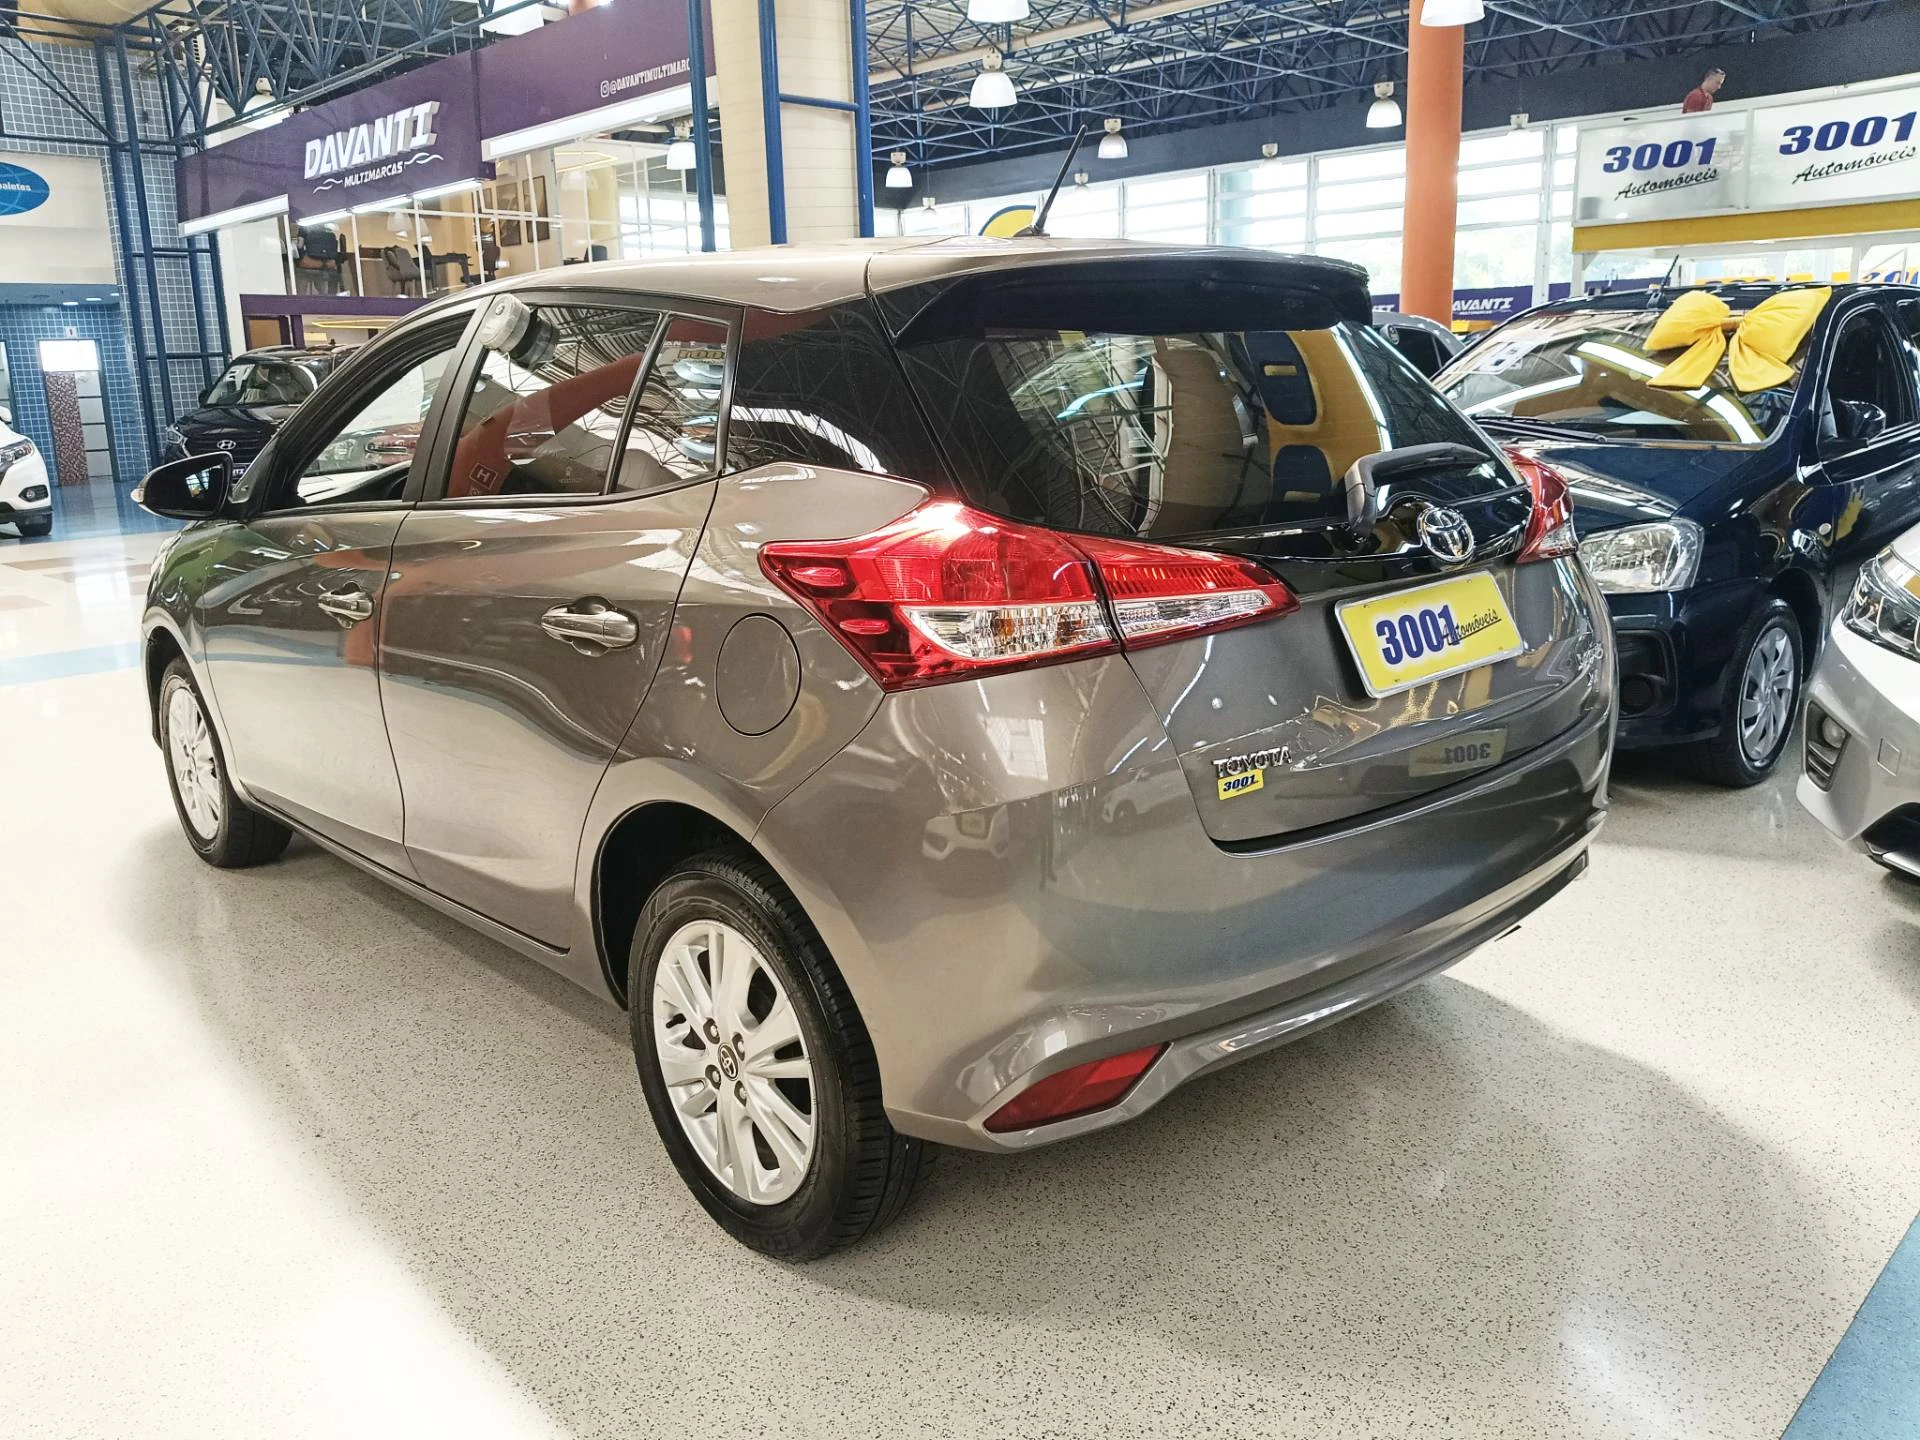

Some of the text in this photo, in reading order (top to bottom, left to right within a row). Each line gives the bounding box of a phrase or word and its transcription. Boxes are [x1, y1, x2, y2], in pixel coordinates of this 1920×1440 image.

[609, 58, 691, 95] @DAVANTIMULTIMARC
[304, 101, 440, 180] DAVANTI
[1779, 111, 1917, 155] 3001
[1603, 137, 1717, 173] 3001
[1792, 147, 1917, 185] Automóveis
[344, 161, 404, 188] MULTIMARCAS
[1614, 167, 1720, 201] Automóveis
[1453, 297, 1514, 311] AVANTI
[1376, 604, 1460, 665] 3001
[1212, 745, 1293, 778] TOYOTA
[1223, 774, 1257, 792] 3001
